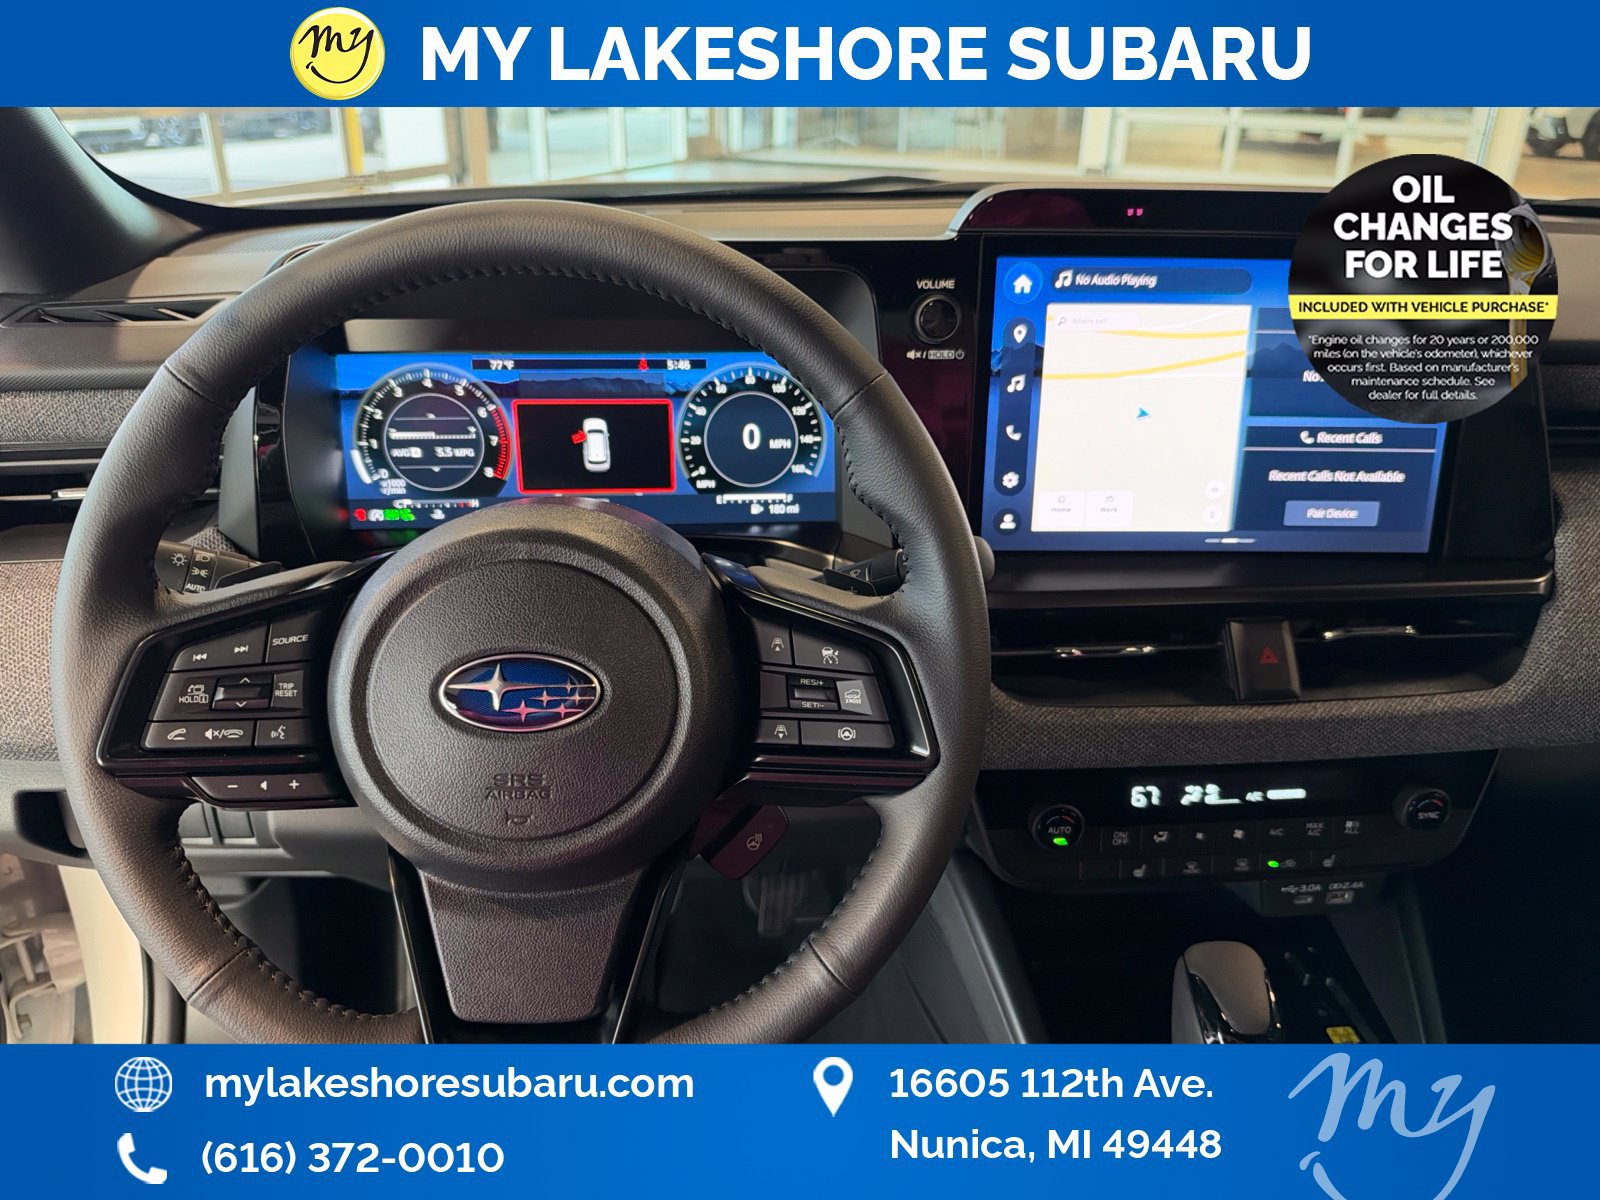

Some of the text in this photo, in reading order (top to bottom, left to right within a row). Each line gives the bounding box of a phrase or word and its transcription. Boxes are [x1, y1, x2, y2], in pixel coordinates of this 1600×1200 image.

[916, 279, 956, 290] VOLUME
[1075, 273, 1158, 288] No Audio Playing
[929, 351, 954, 360] HOLD
[422, 378, 433, 388] 4
[744, 375, 756, 385] 80
[393, 386, 403, 397] 3
[454, 385, 465, 396] 5
[715, 384, 727, 394] 60
[771, 384, 786, 394] 100
[373, 409, 383, 419] 2
[477, 407, 487, 418] 6
[695, 406, 707, 416] 40
[791, 407, 806, 416] 120
[489, 435, 498, 446] 7
[690, 436, 701, 446] 20
[742, 423, 791, 450] 0 MPH
[799, 434, 814, 444] 140
[1316, 432, 1383, 444] Recent Calls
[453, 448, 475, 457] MPG
[379, 468, 389, 479] 0
[484, 467, 494, 478] 8
[698, 465, 706, 475] 0
[791, 464, 806, 474] 160
[1268, 470, 1406, 483] Recent Calls Not Available
[696, 479, 716, 489] MPH
[786, 503, 799, 514] mi
[1306, 508, 1359, 519] Pair Device
[186, 583, 206, 592] AUTO
[272, 634, 309, 646] SOURCE
[800, 678, 824, 686] RES/+
[275, 689, 298, 697] RESET
[494, 774, 546, 787] SRS
[485, 787, 553, 800] AIRBAG
[1130, 785, 1161, 809] 67
[1417, 811, 1440, 820] SYNC
[1047, 826, 1072, 834] AUTO
[1112, 838, 1129, 846] OFF
